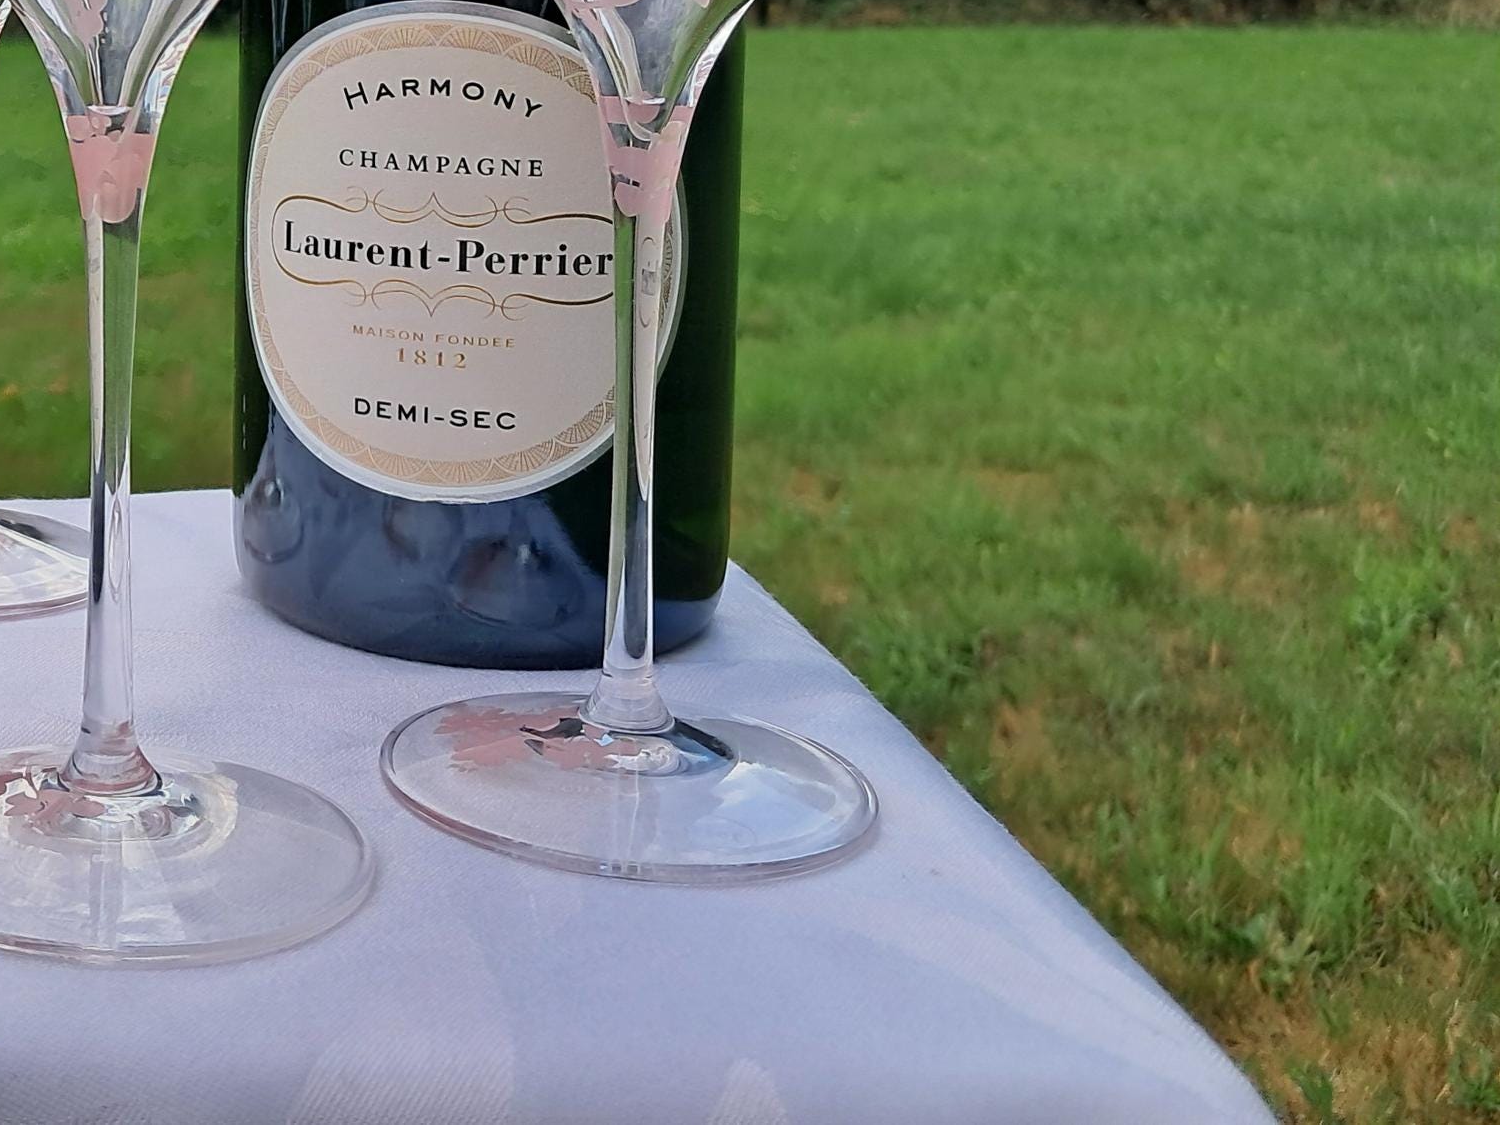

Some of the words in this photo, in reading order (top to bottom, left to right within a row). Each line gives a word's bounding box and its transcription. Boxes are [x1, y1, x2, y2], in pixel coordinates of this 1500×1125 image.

[343, 77, 545, 119] HARMONY
[338, 148, 545, 178] CHAMPAGNE
[283, 219, 614, 277] Laurent-Perrier
[352, 324, 425, 342] MAISON
[396, 347, 468, 369] 1812
[354, 397, 518, 431] DEMI-SEC
